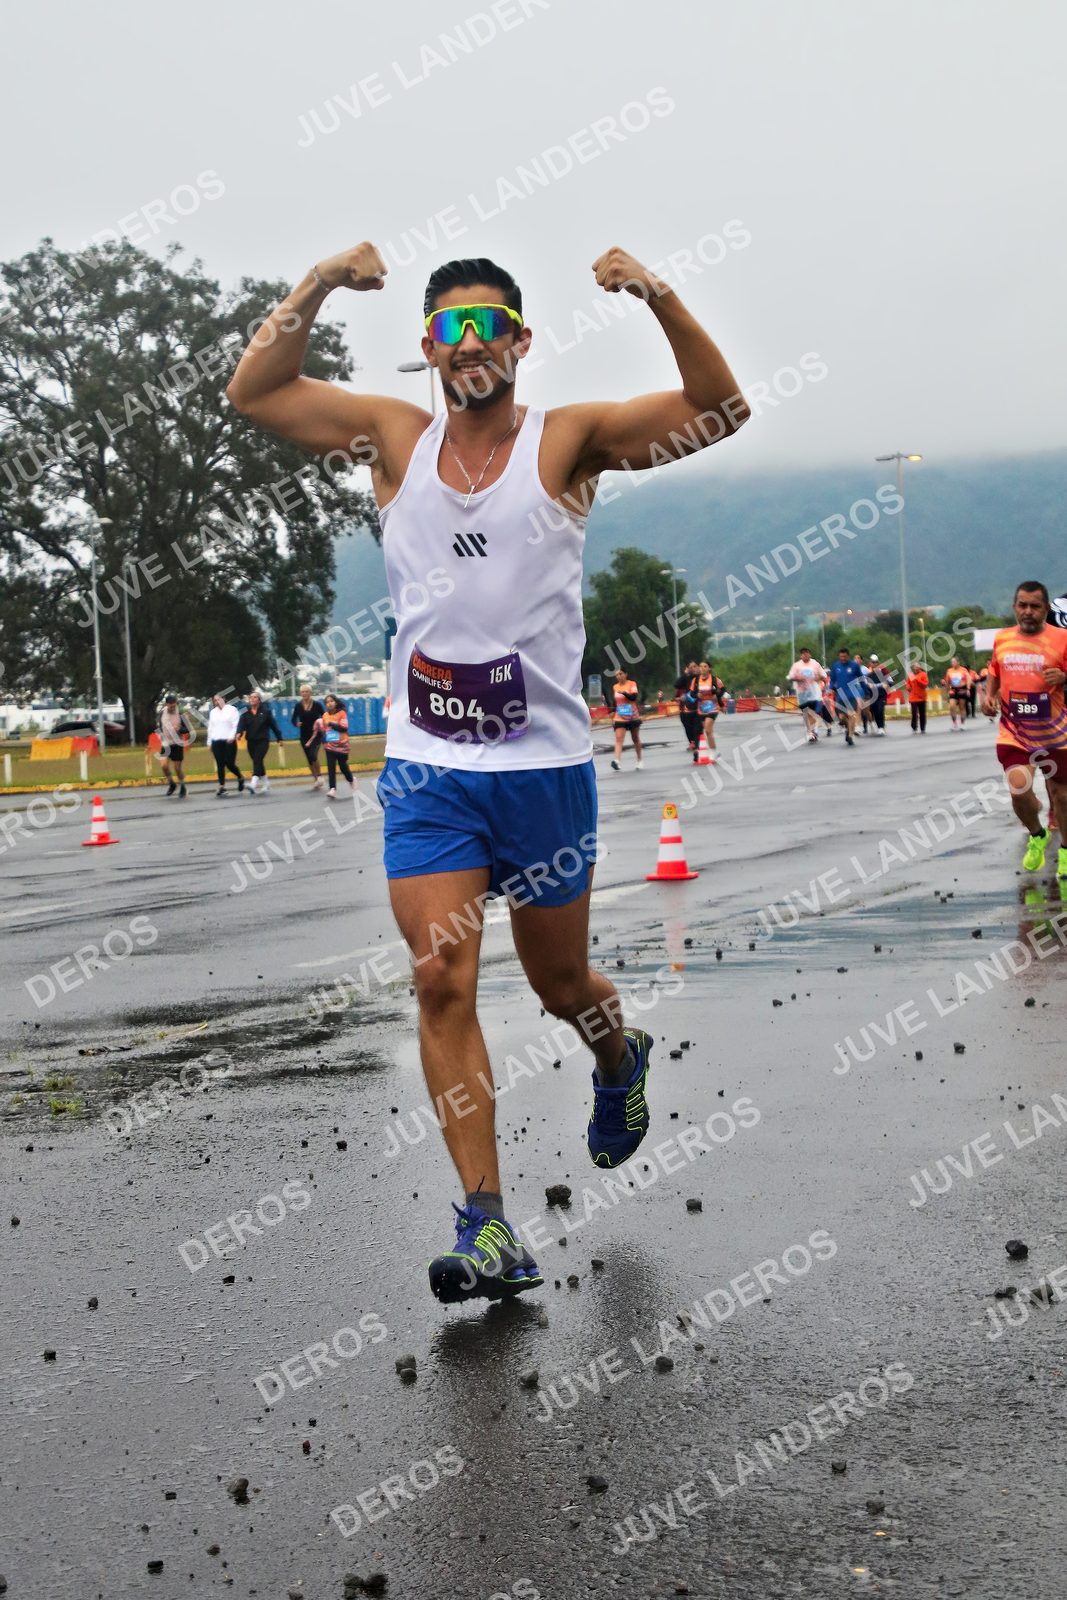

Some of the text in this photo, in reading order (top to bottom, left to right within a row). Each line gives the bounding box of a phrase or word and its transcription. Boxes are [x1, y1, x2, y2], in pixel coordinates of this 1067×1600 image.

[412, 655, 453, 680] CARRERA
[489, 663, 513, 684] 15K
[412, 668, 442, 689] OMNILIFE
[429, 692, 485, 721] 804
[1017, 703, 1039, 714] 389
